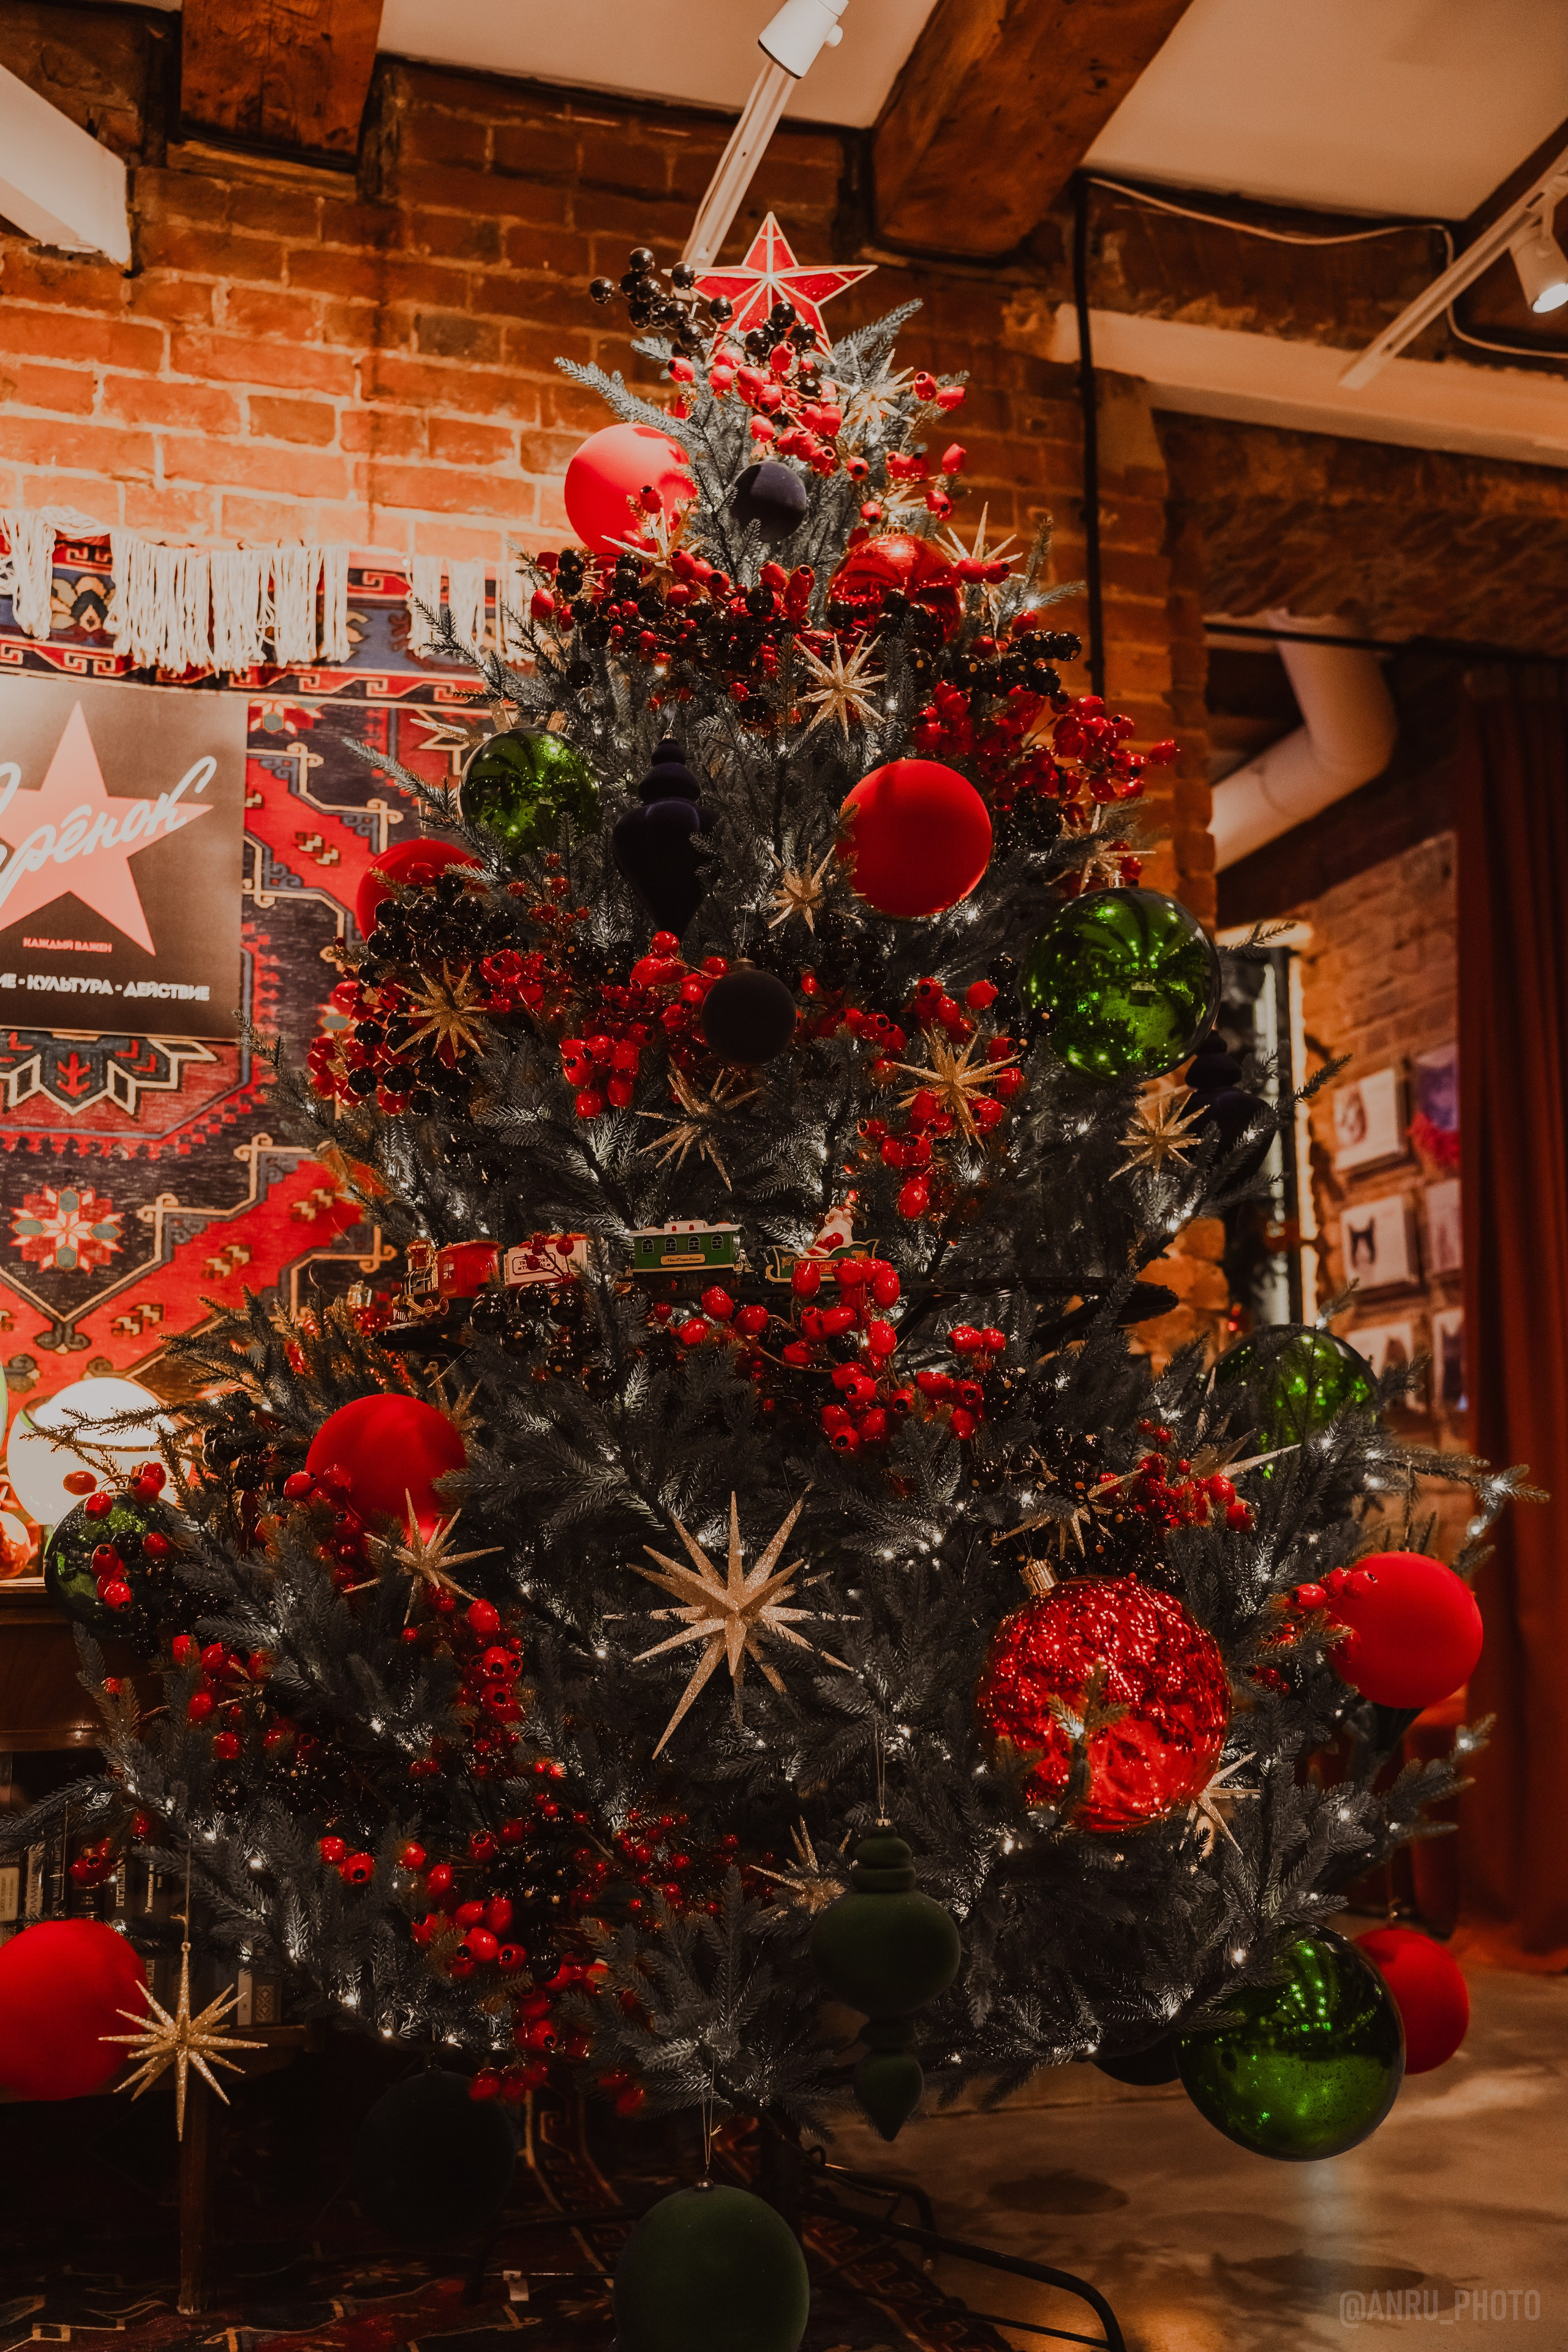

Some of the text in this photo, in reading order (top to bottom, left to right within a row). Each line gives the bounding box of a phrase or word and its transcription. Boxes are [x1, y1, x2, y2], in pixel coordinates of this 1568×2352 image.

[23, 937, 112, 953] КАЖДЫЙ ВАЖЕН
[27, 974, 114, 995] КУЛЬТУРА
[123, 981, 210, 1001] ДЕЙСТВИЕ
